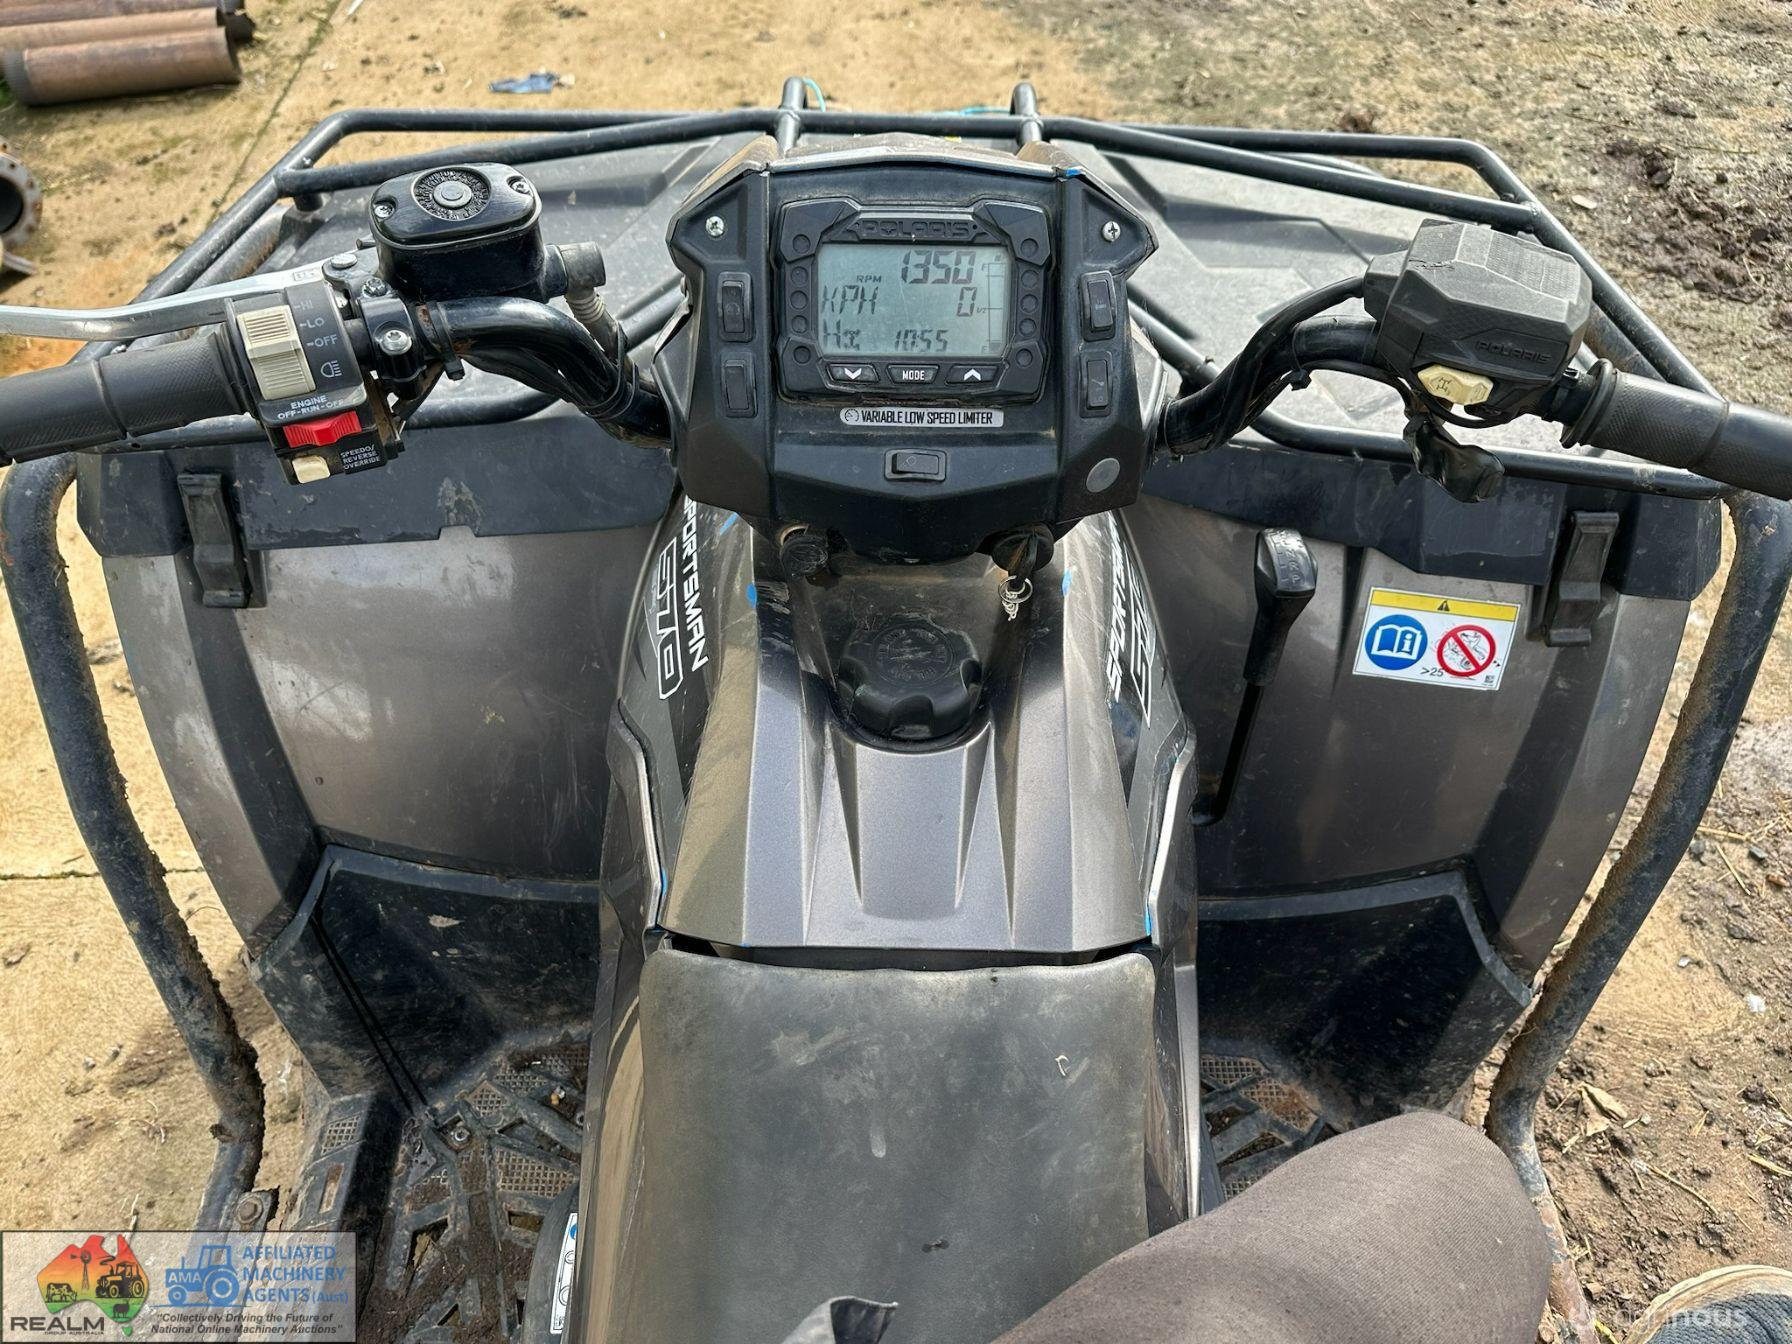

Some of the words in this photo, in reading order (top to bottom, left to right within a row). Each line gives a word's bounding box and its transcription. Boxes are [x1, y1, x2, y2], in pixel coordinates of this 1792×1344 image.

[861, 220, 970, 237] POLARIS
[901, 250, 976, 285] 1350
[856, 275, 882, 283] RPM
[821, 285, 879, 315] KPH
[957, 287, 978, 317] 0
[894, 329, 949, 352] 10:55
[1476, 341, 1553, 364] POLARIS
[902, 369, 925, 380] MODE
[290, 395, 327, 409] ENGINE
[861, 410, 903, 423] VARIABLE
[905, 411, 925, 424] LOW
[927, 411, 956, 424] SPEED
[958, 411, 993, 424] LIMITER
[342, 451, 378, 464] REVERSE
[343, 456, 380, 470] OVERRIDE
[656, 536, 684, 699] 570
